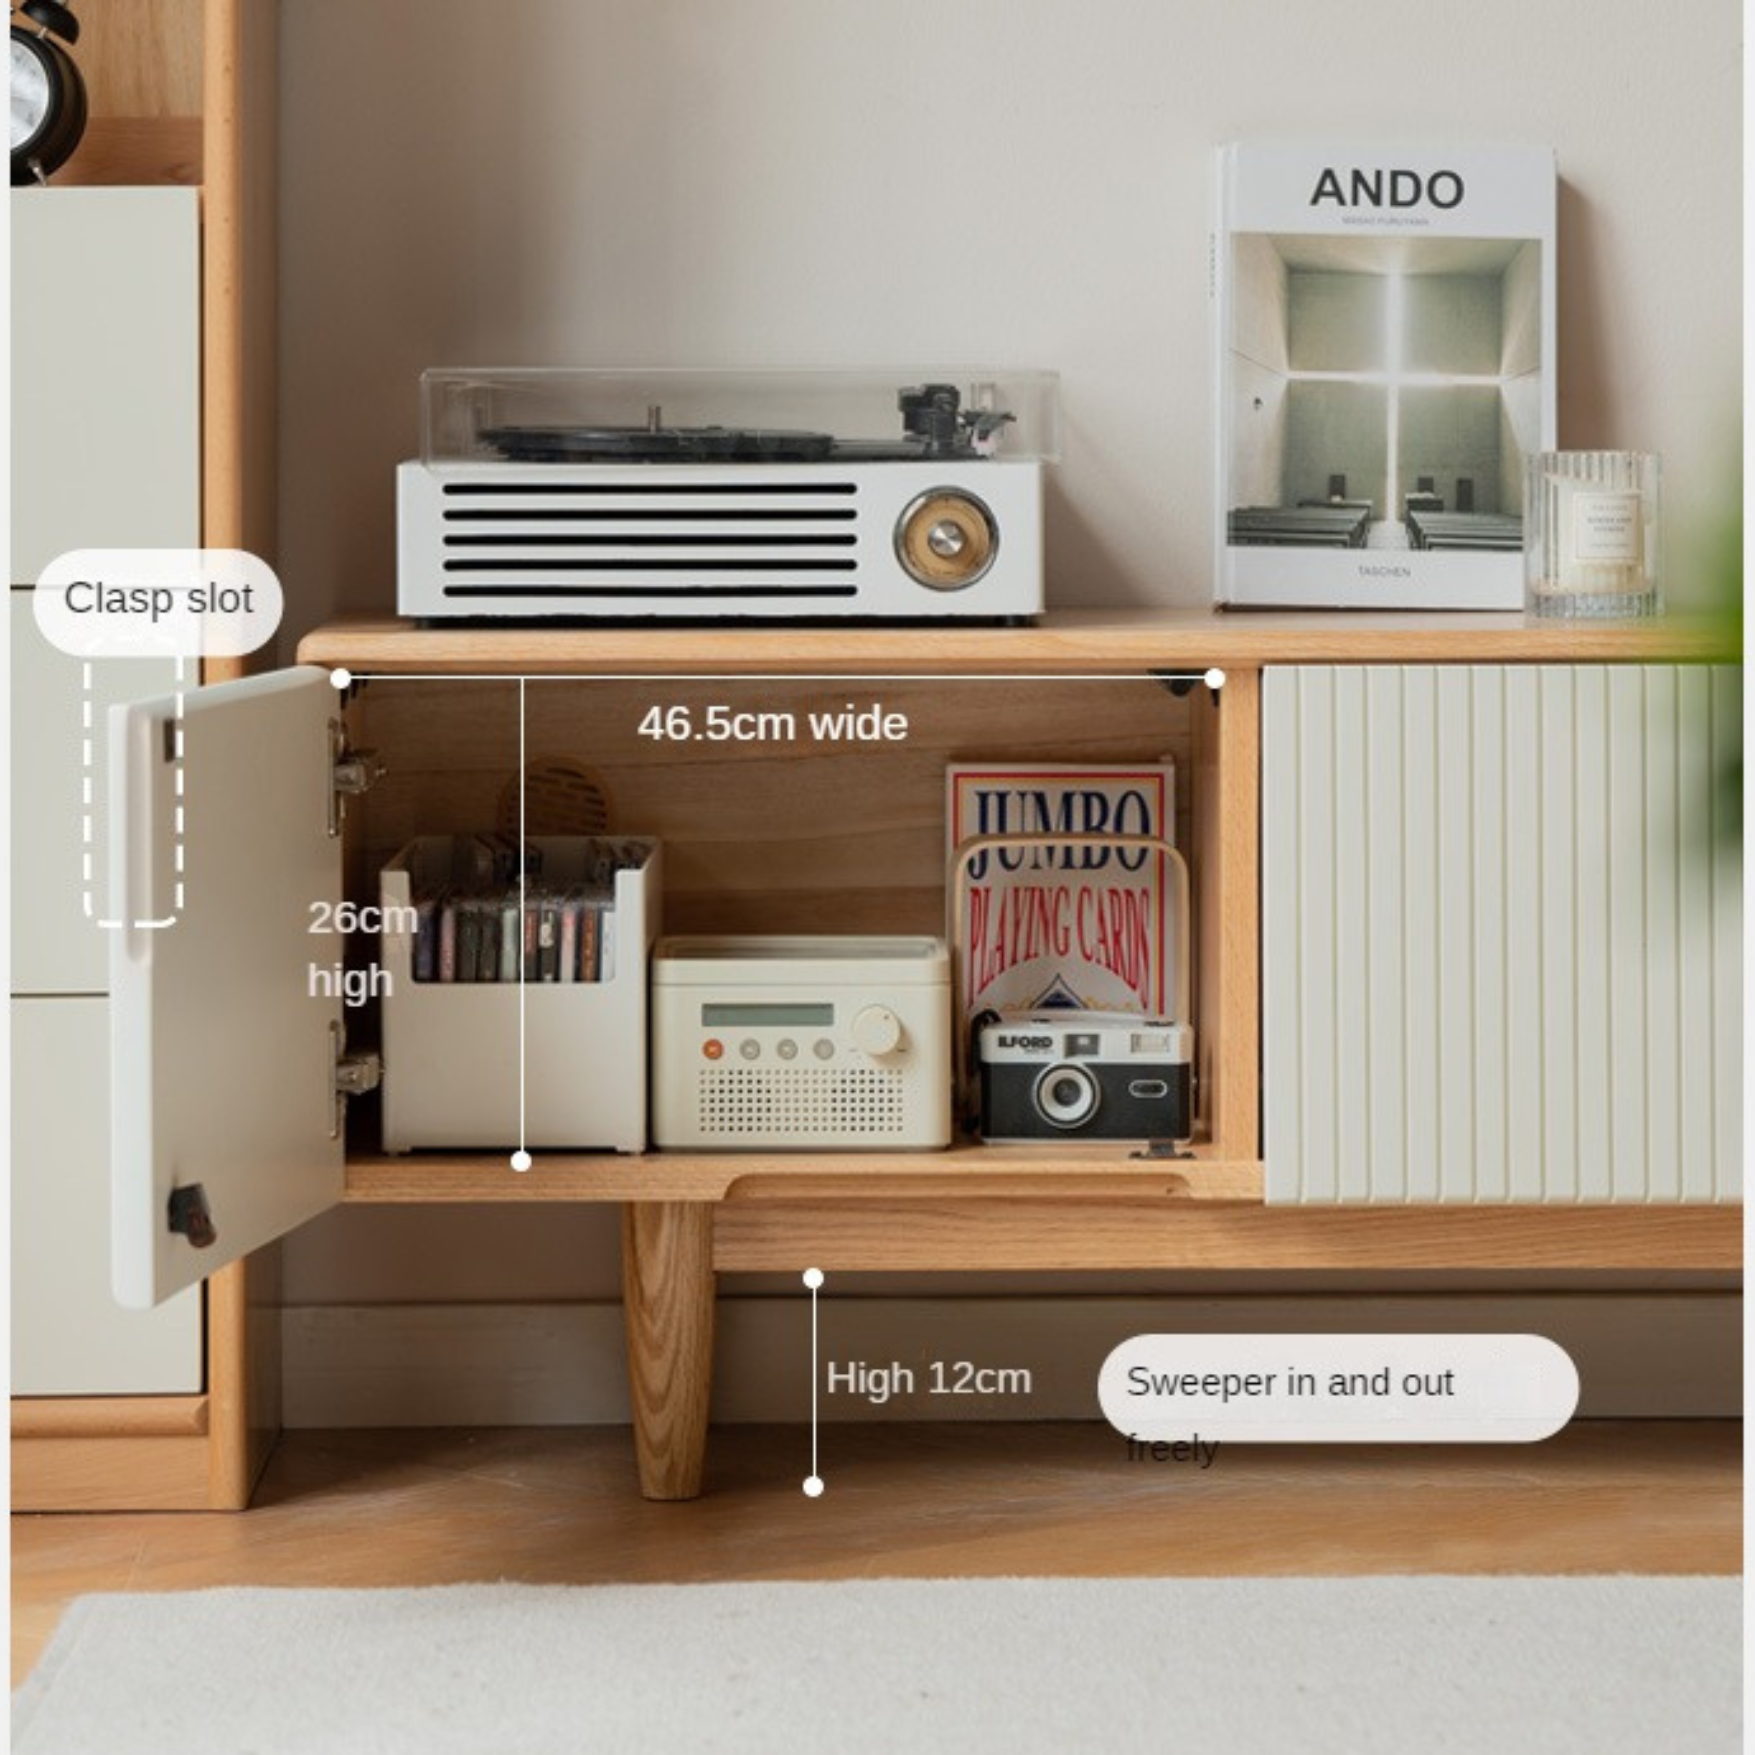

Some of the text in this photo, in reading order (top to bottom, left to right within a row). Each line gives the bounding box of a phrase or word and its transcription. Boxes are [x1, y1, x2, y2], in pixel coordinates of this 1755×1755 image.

[1310, 167, 1465, 209] ANDO
[967, 789, 1150, 880] JUMBO
[968, 885, 1150, 1010] PLAYING CARDS
[998, 1035, 1053, 1049] ILFORD
